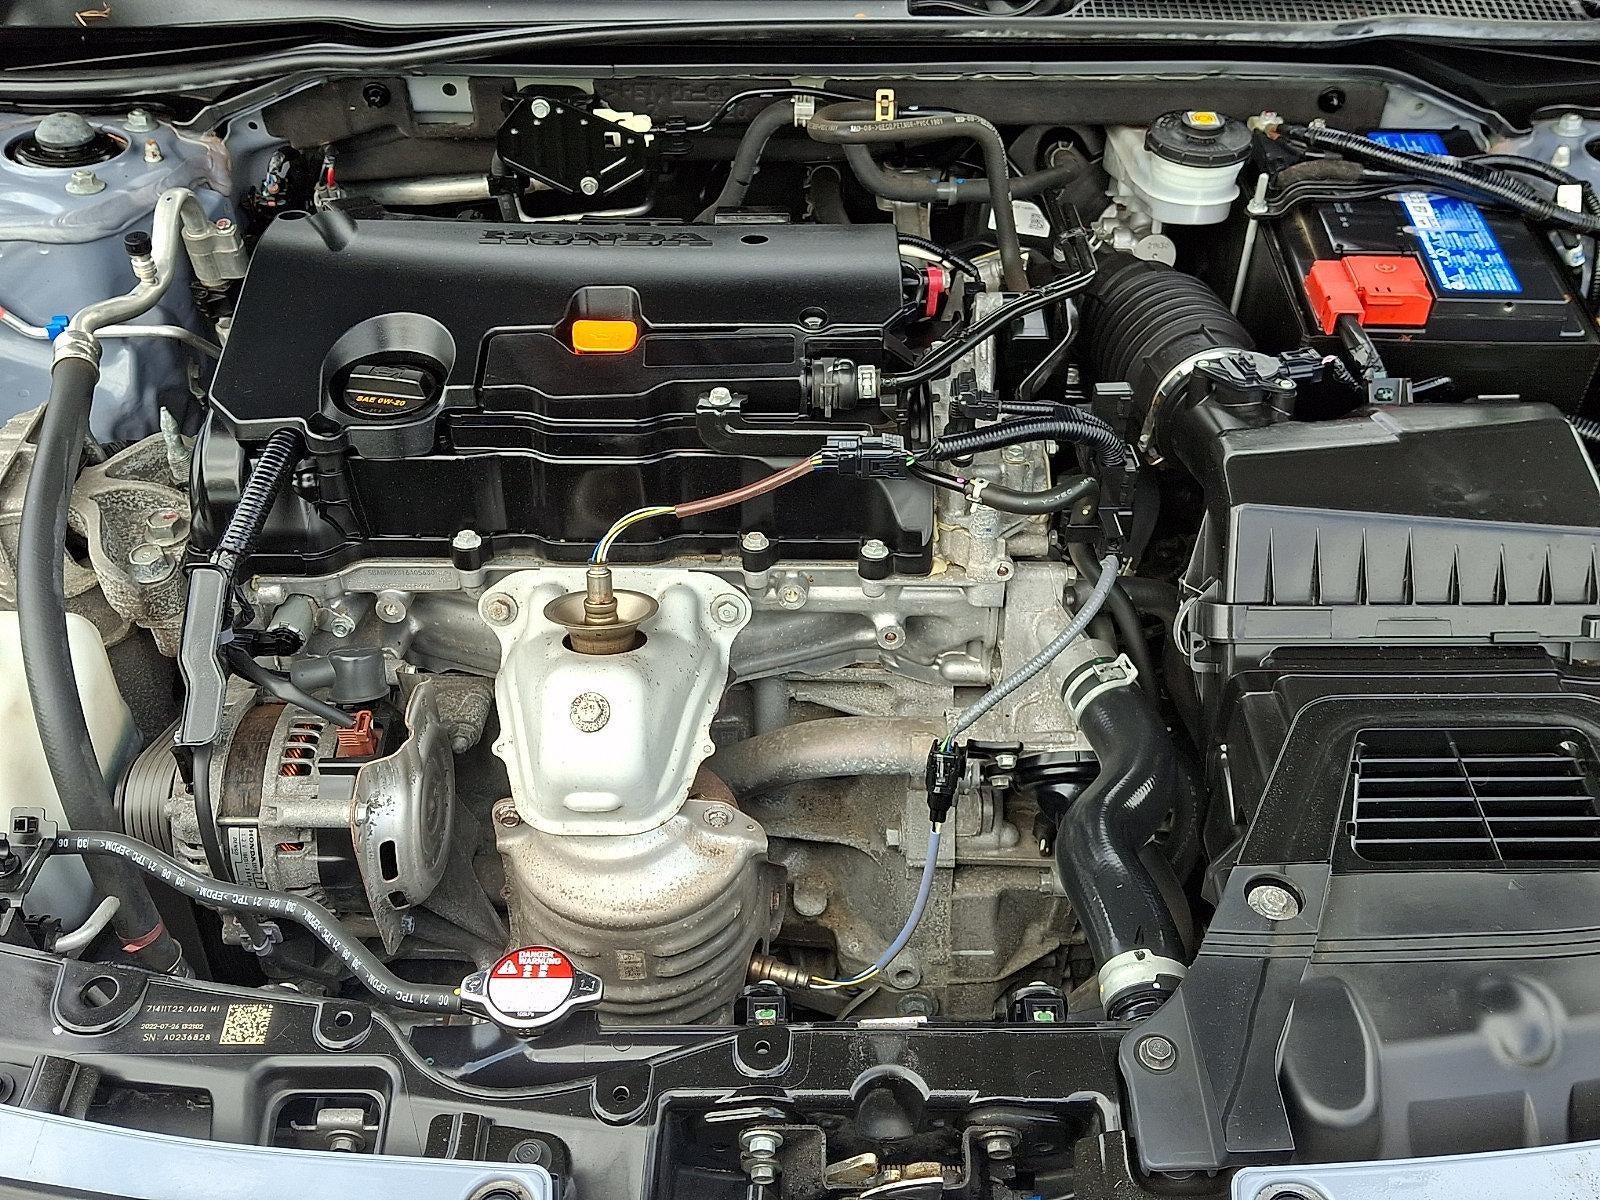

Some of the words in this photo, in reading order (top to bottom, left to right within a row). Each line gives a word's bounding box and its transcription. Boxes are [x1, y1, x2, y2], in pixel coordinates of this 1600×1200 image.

[479, 229, 713, 247] HONDA
[355, 395, 376, 403] SAE
[377, 397, 406, 407] 0W-20
[1041, 488, 1073, 504] Y-TEC
[57, 838, 69, 848] 06
[100, 840, 131, 856] >EPDM<
[248, 829, 257, 863] HONDA
[131, 854, 146, 866] TPC
[147, 860, 158, 872] 21
[196, 885, 228, 901] >EPDM<
[232, 896, 249, 906] TPC
[252, 896, 263, 907] 21
[519, 957, 562, 965] WARNING
[366, 972, 391, 995] >EPDM<
[395, 990, 414, 1004] TPC
[419, 994, 430, 1005] 21
[146, 1005, 185, 1013] 71411T22
[187, 1005, 208, 1013] A014
[210, 1005, 221, 1013] M1
[142, 1033, 159, 1042] SN:
[163, 1033, 211, 1041] A0236828
